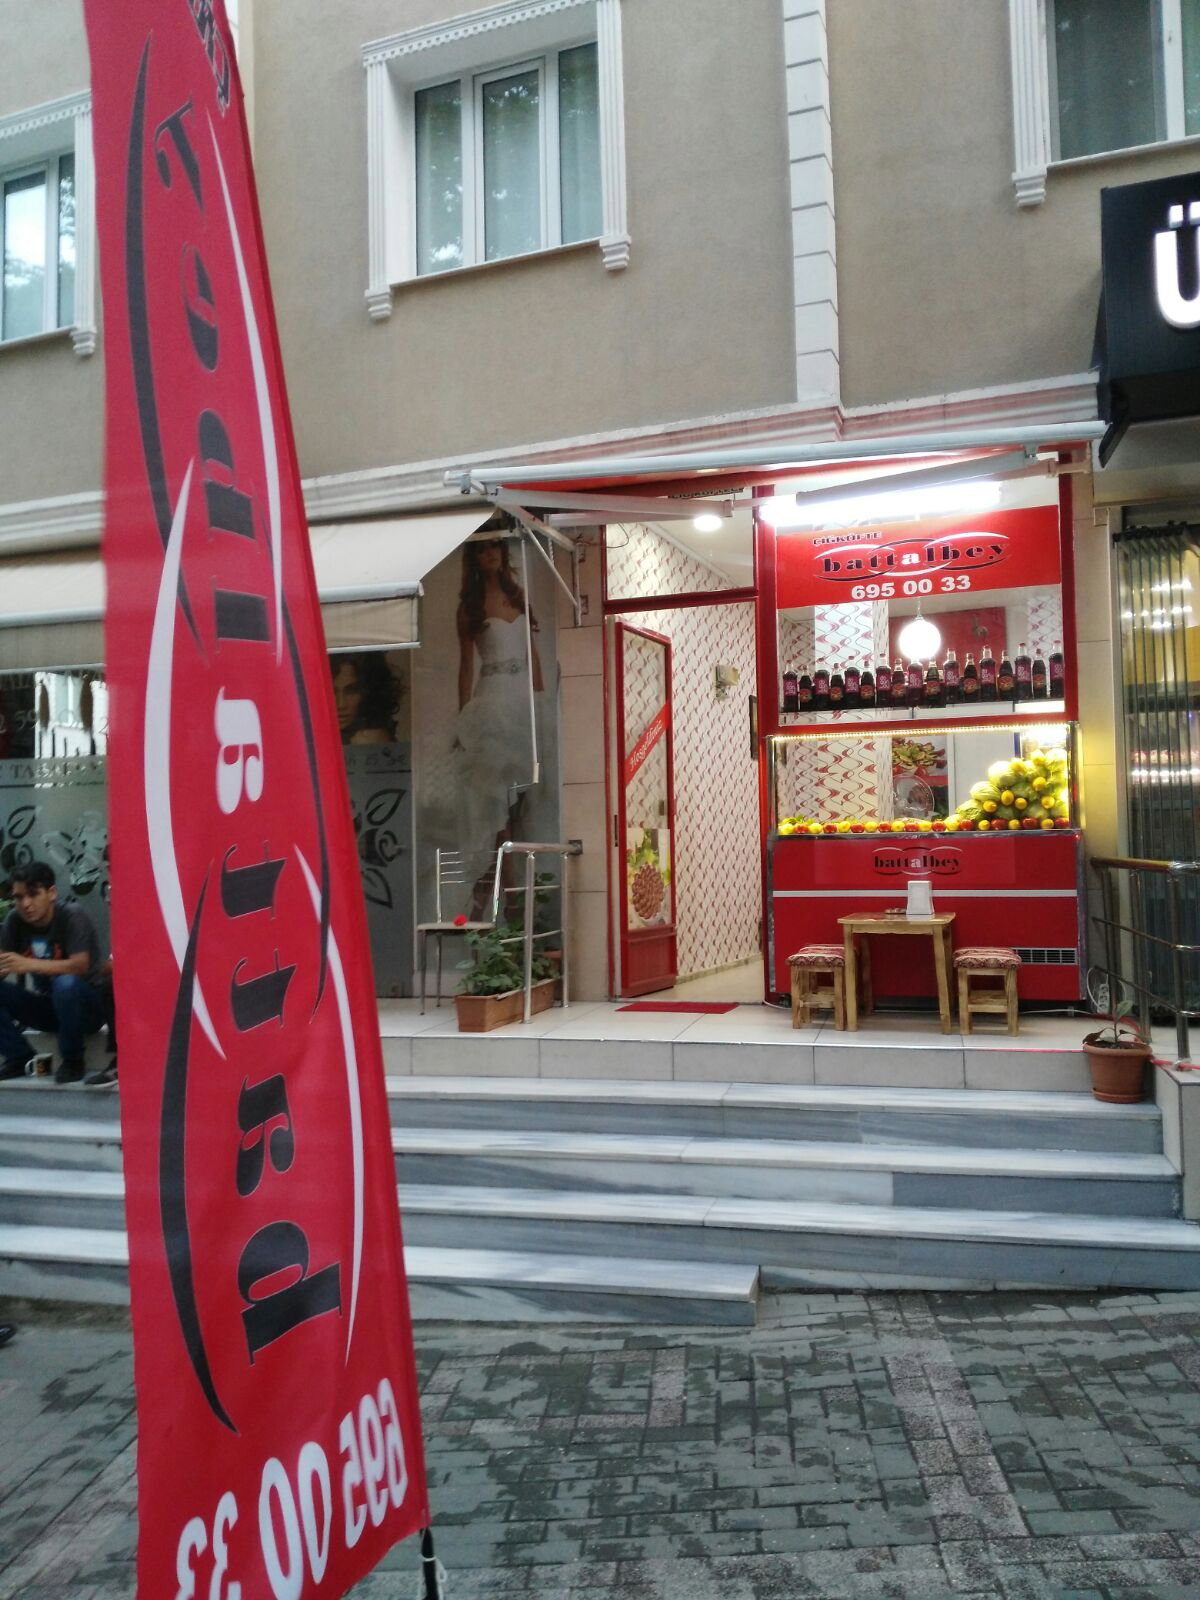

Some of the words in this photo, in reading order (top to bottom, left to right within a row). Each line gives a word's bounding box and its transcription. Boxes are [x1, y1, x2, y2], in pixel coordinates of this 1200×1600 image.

[822, 543, 1010, 573] battalbey
[851, 582, 895, 600] 695
[903, 578, 932, 595] 00
[941, 575, 971, 592] 33
[874, 854, 960, 871] battalbey
